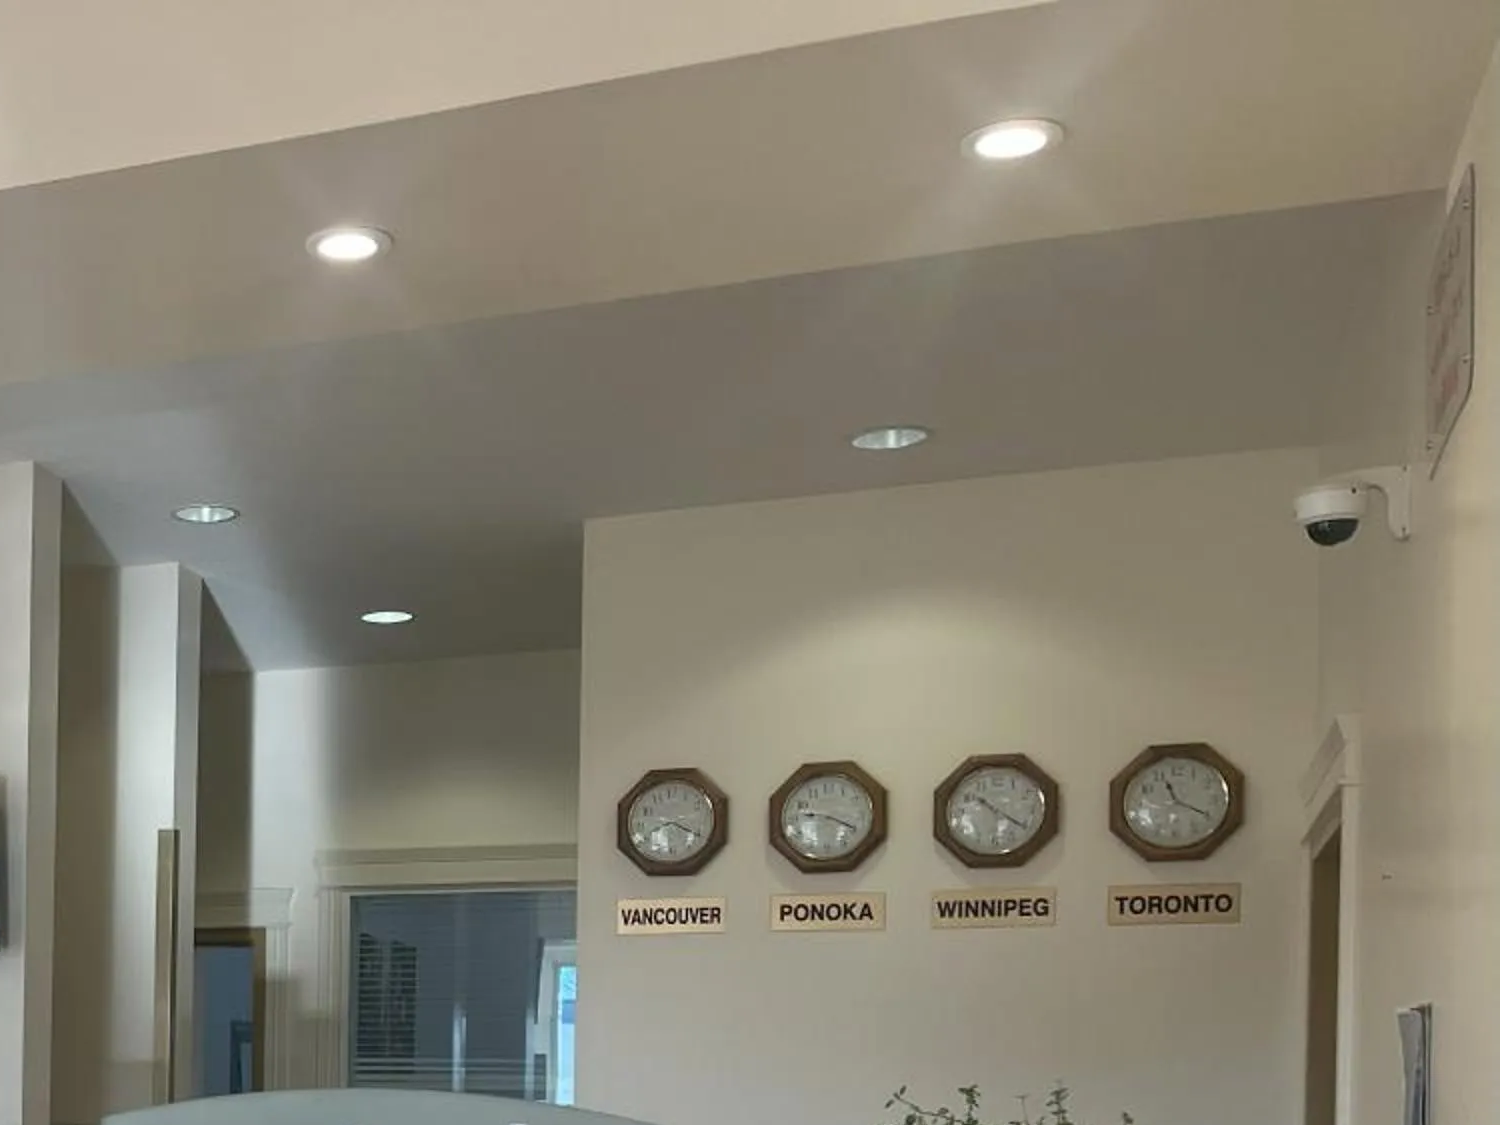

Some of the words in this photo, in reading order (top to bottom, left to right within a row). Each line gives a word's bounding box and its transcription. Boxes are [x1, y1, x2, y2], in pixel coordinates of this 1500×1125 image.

[779, 902, 874, 922] PONOKA
[936, 897, 1050, 919] WINNIPEG
[1114, 893, 1233, 915] TORONTO
[621, 906, 722, 926] VANCOUVER
